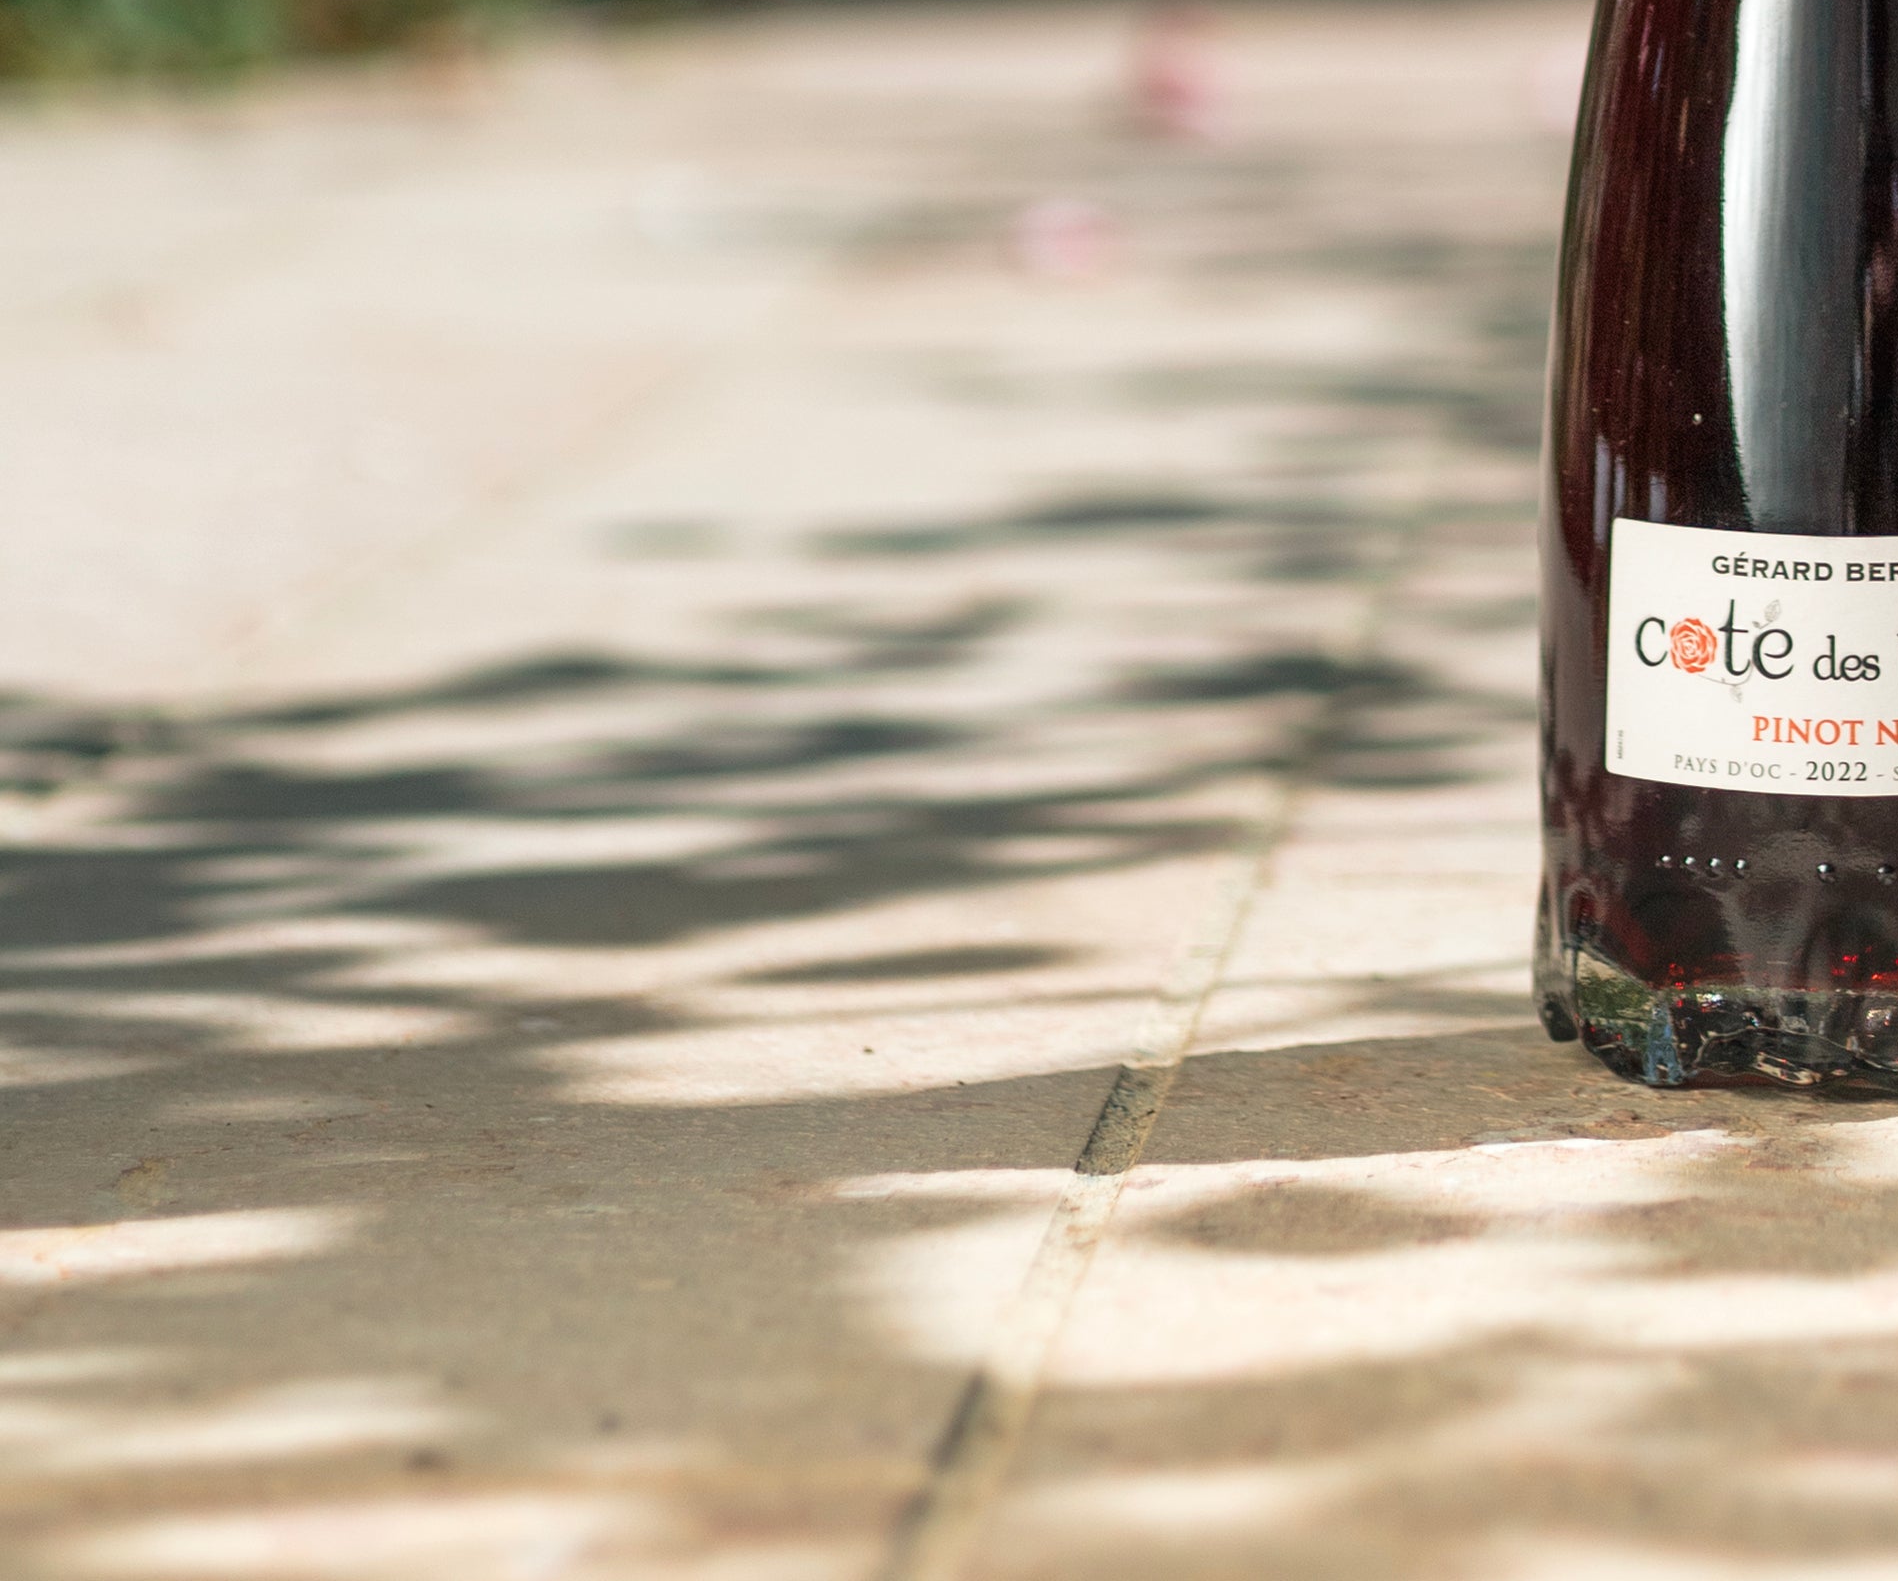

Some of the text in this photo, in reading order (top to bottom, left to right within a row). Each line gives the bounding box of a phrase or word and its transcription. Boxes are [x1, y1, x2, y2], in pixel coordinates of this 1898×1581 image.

[1711, 551, 1834, 582] GÉRARD
[1811, 634, 1882, 682] des
[1752, 715, 1865, 746] PINOT
[1673, 754, 1718, 775] PAYS
[1728, 759, 1782, 780] D'OC
[1805, 760, 1868, 782] 2022
